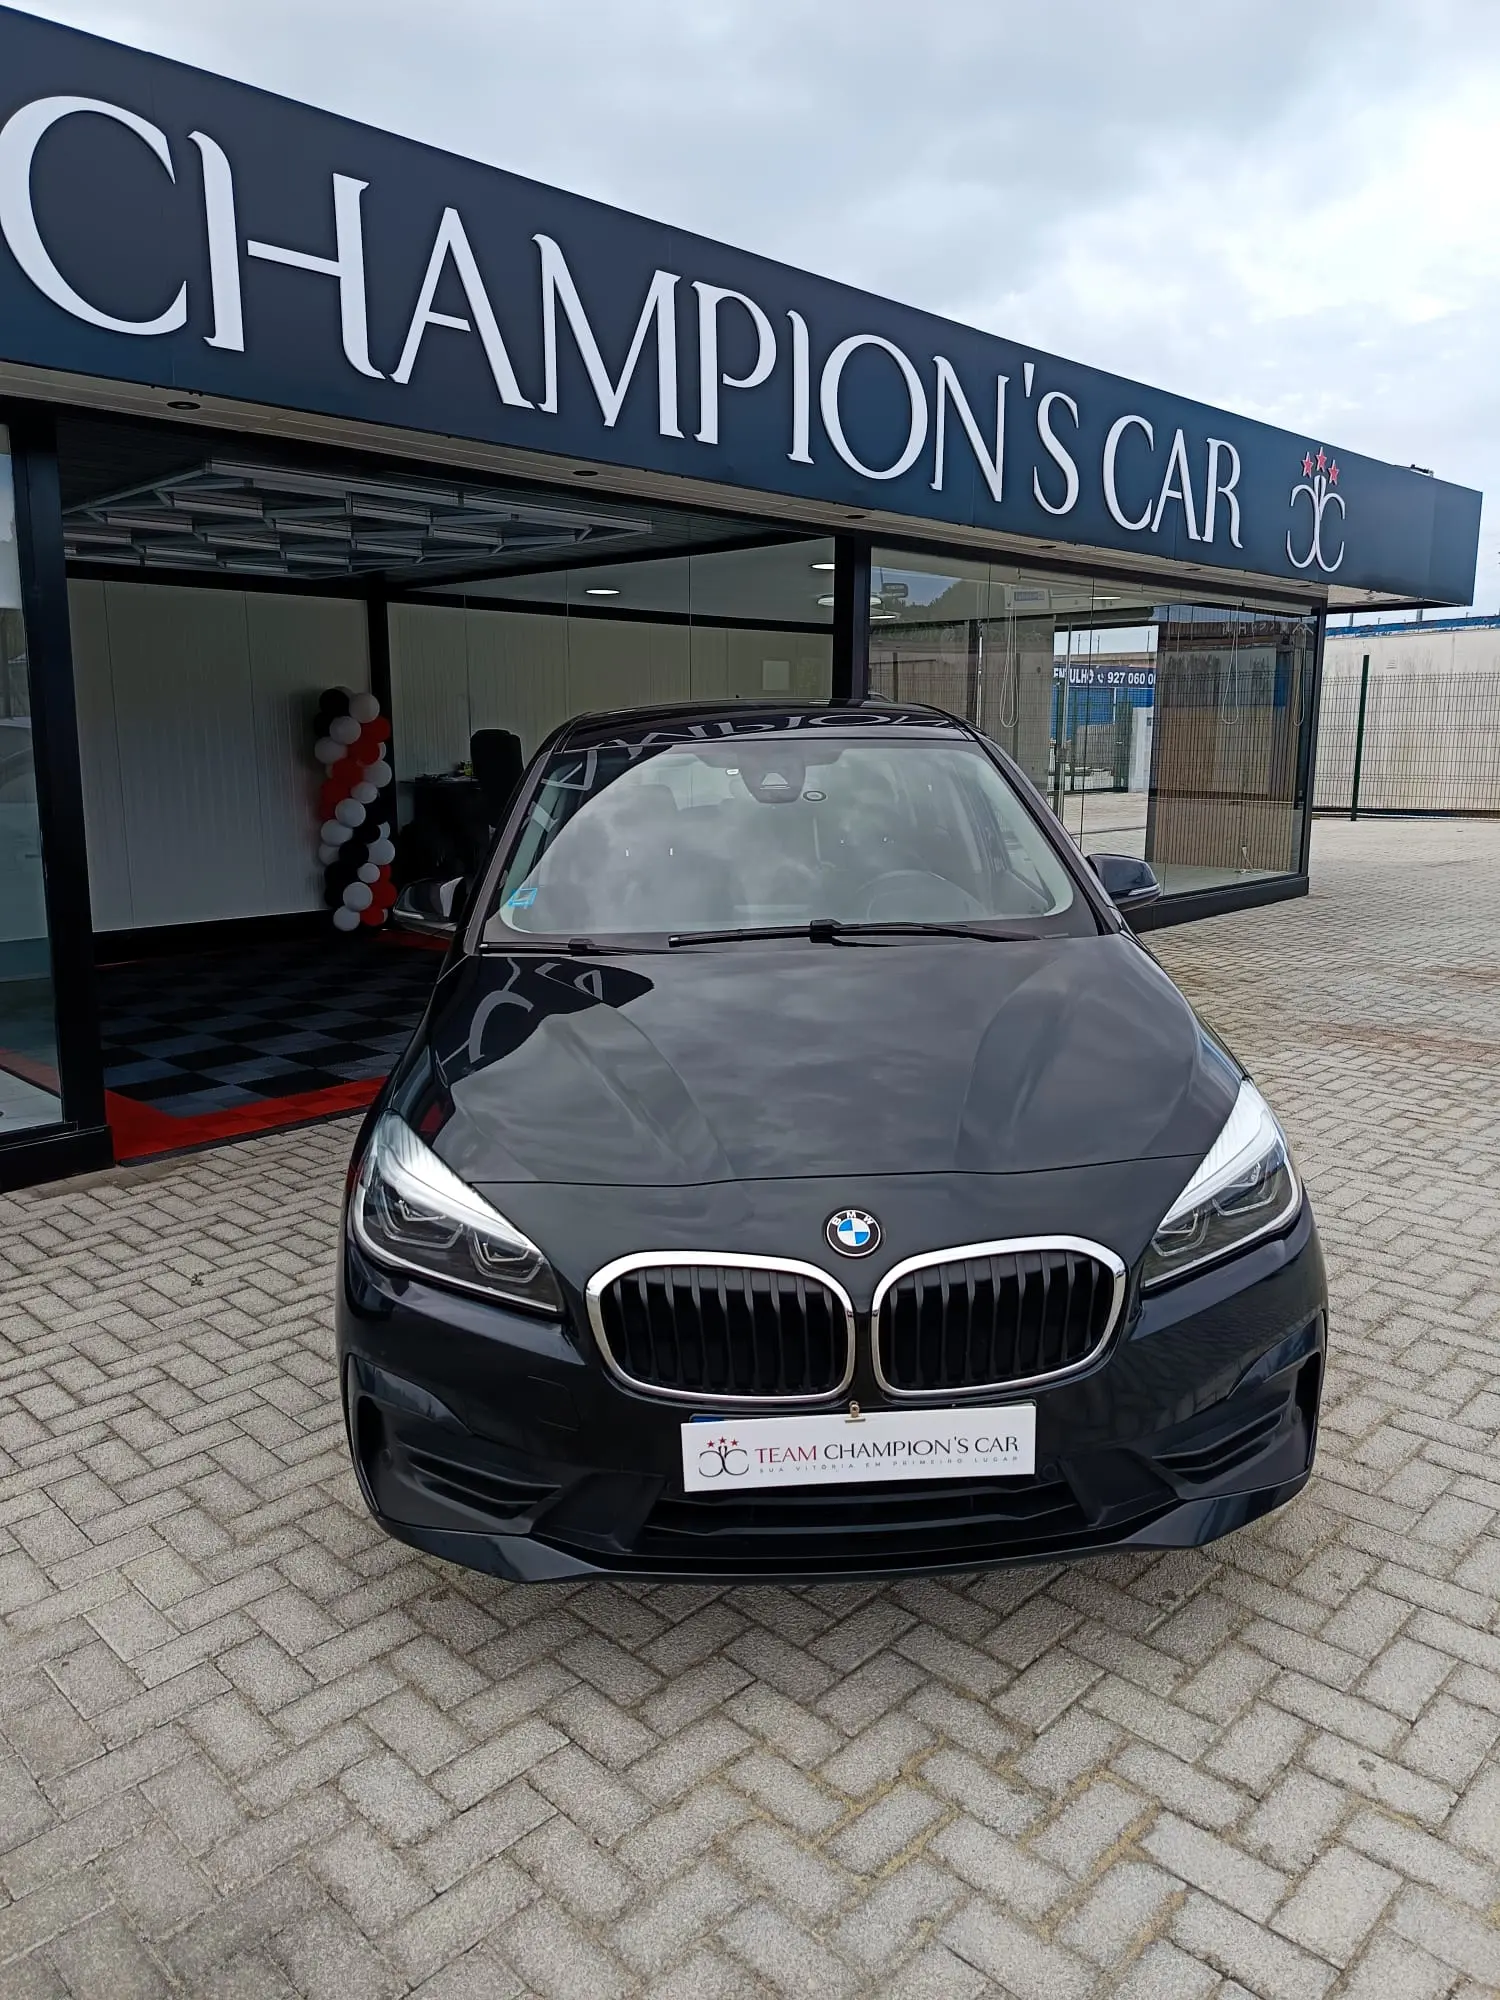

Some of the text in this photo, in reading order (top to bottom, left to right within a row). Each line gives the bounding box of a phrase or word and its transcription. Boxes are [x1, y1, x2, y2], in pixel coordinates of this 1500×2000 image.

[0, 95, 1243, 549] CHAMPION'S CAR
[1107, 671, 1126, 684] 927
[1127, 672, 1146, 685] 060
[831, 1210, 874, 1225] BMW
[754, 1436, 1020, 1464] TEAM CHAMPION'S CAR
